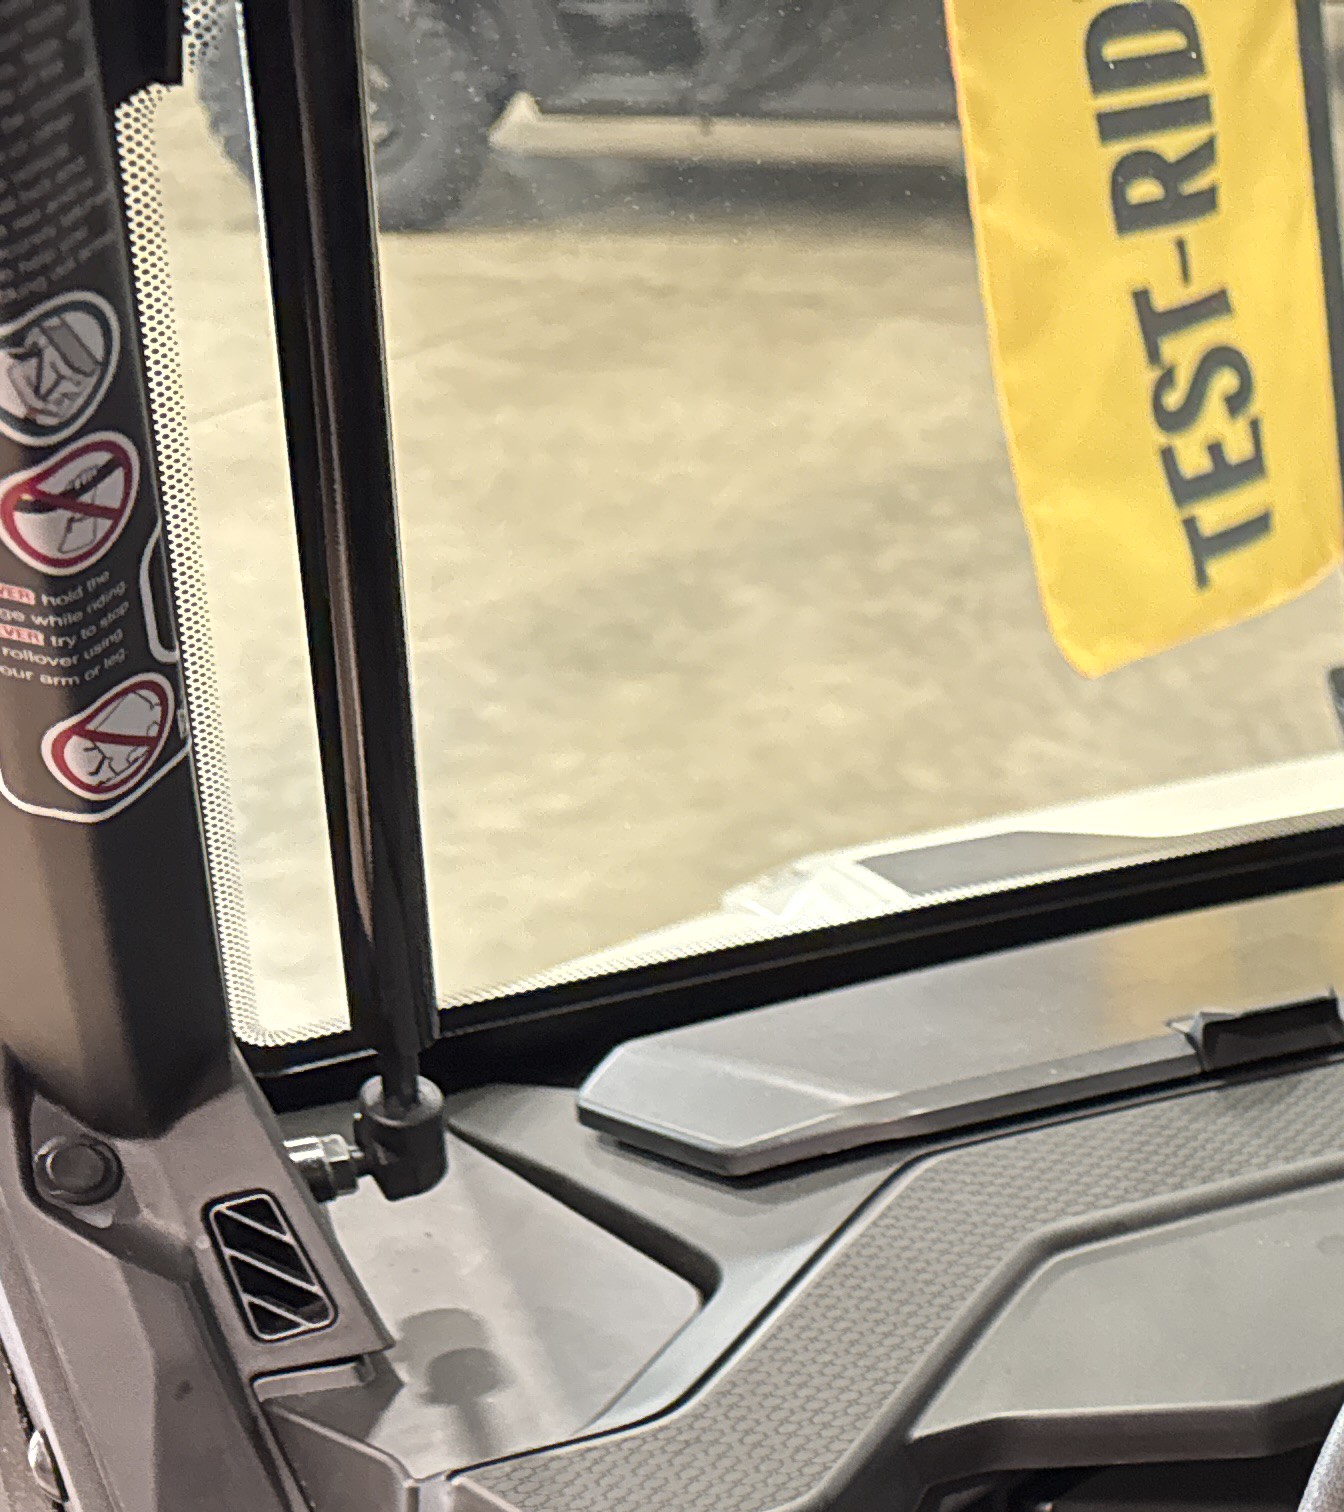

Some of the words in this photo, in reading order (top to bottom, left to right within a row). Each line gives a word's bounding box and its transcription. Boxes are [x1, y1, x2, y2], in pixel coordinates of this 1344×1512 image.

[31, 611, 84, 627] while
[86, 581, 126, 613] riding
[50, 635, 77, 648] try
[80, 625, 97, 640] to
[100, 601, 130, 627] stop
[2, 646, 80, 667] rollover
[83, 628, 123, 660] using
[40, 674, 80, 687] arm
[84, 664, 101, 681] or
